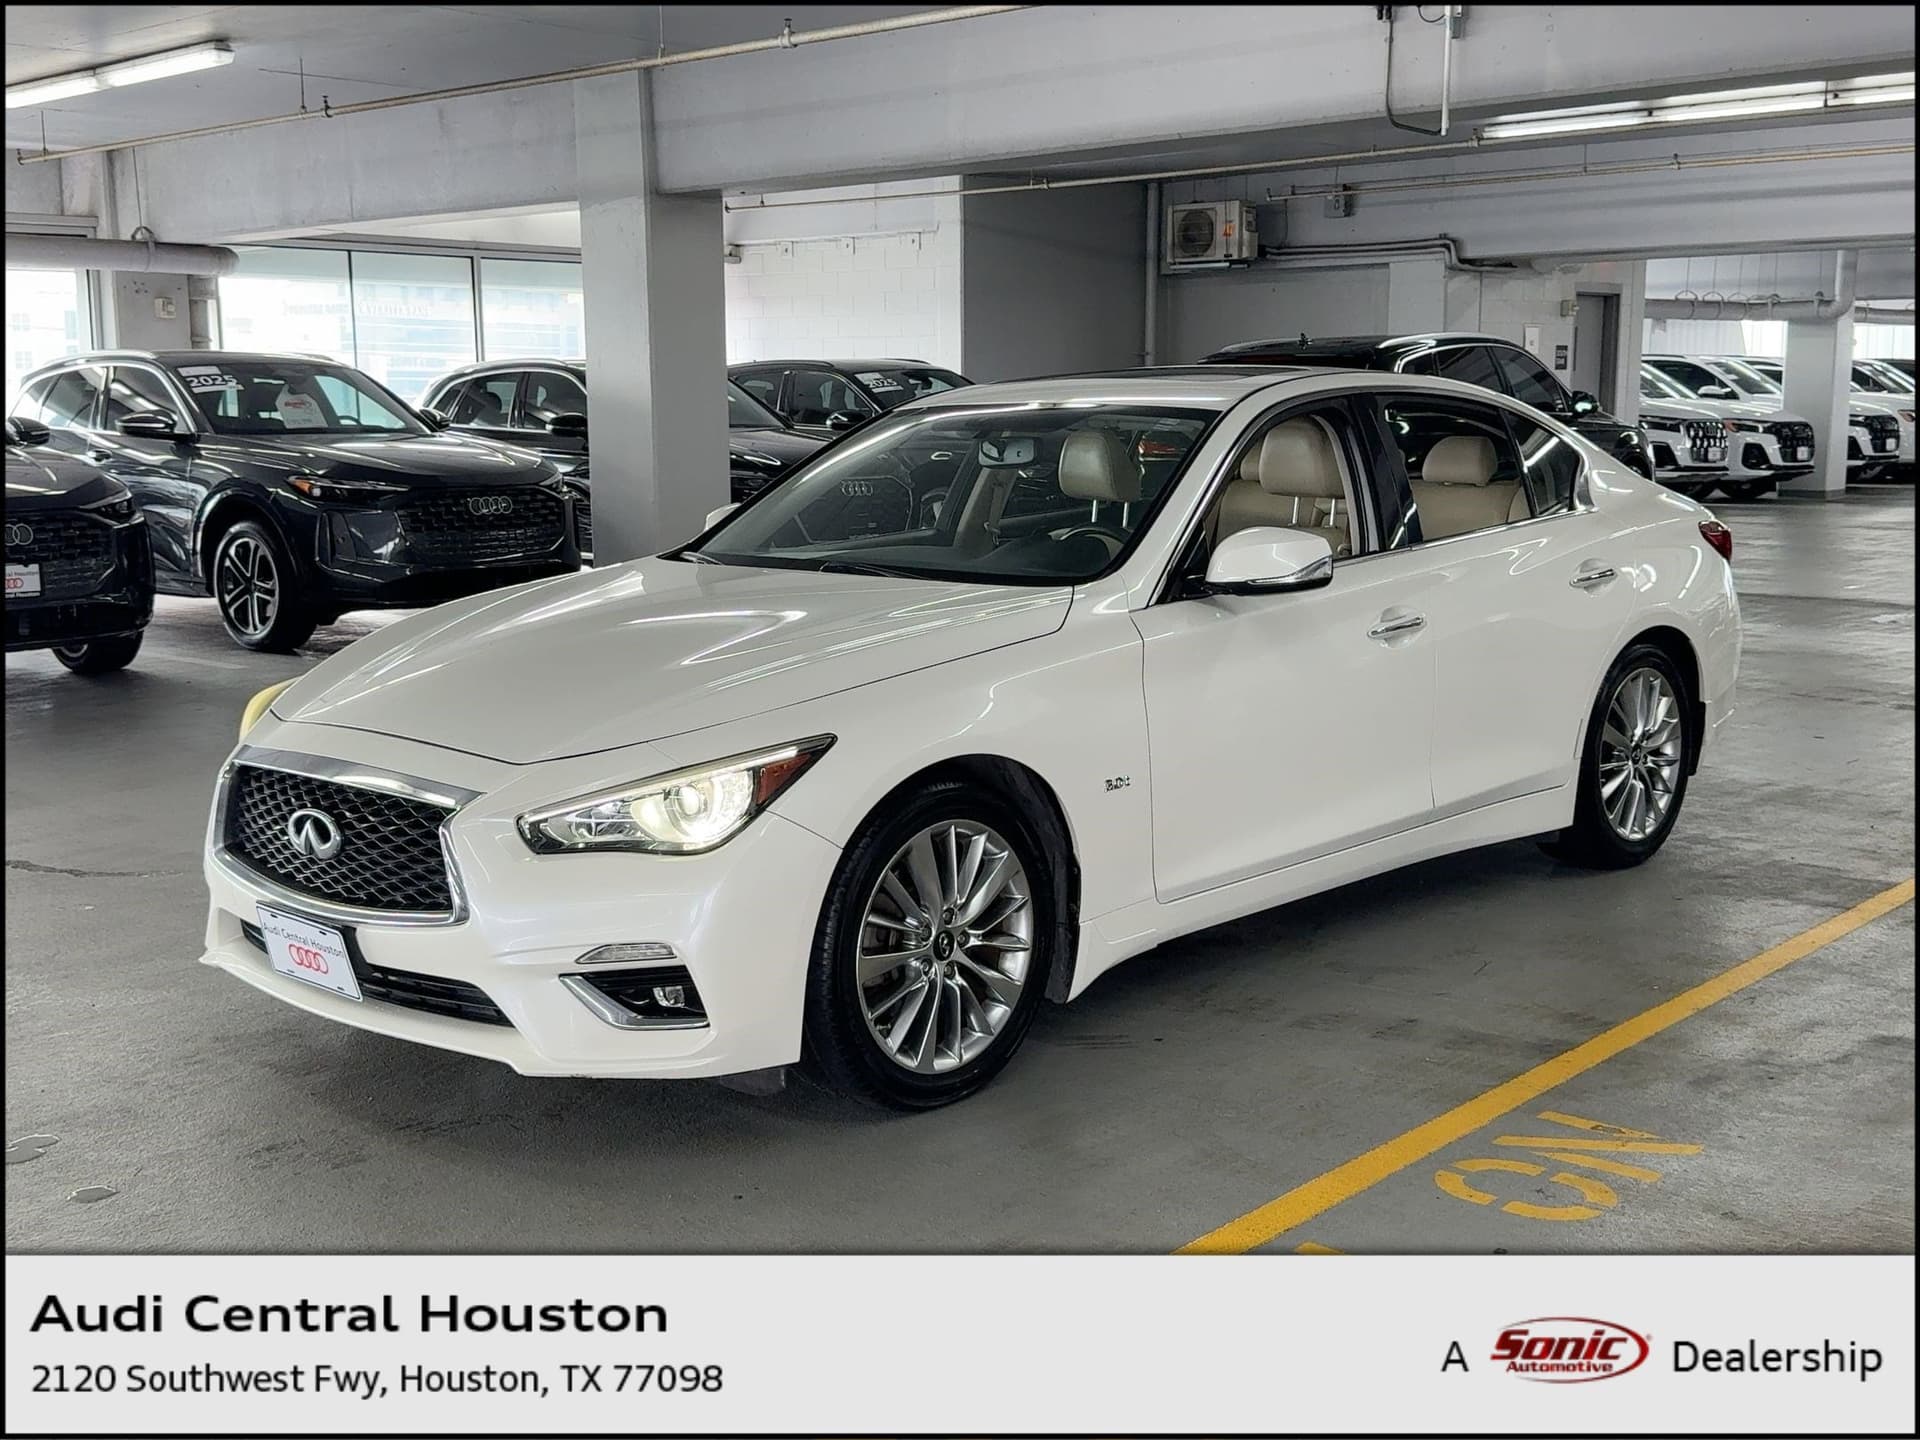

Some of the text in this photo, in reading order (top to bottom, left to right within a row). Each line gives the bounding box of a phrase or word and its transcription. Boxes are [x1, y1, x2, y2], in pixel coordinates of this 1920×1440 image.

[185, 375, 237, 387] 2025
[869, 378, 897, 388] 2025
[281, 928, 309, 946] Central
[310, 938, 345, 958] Houston
